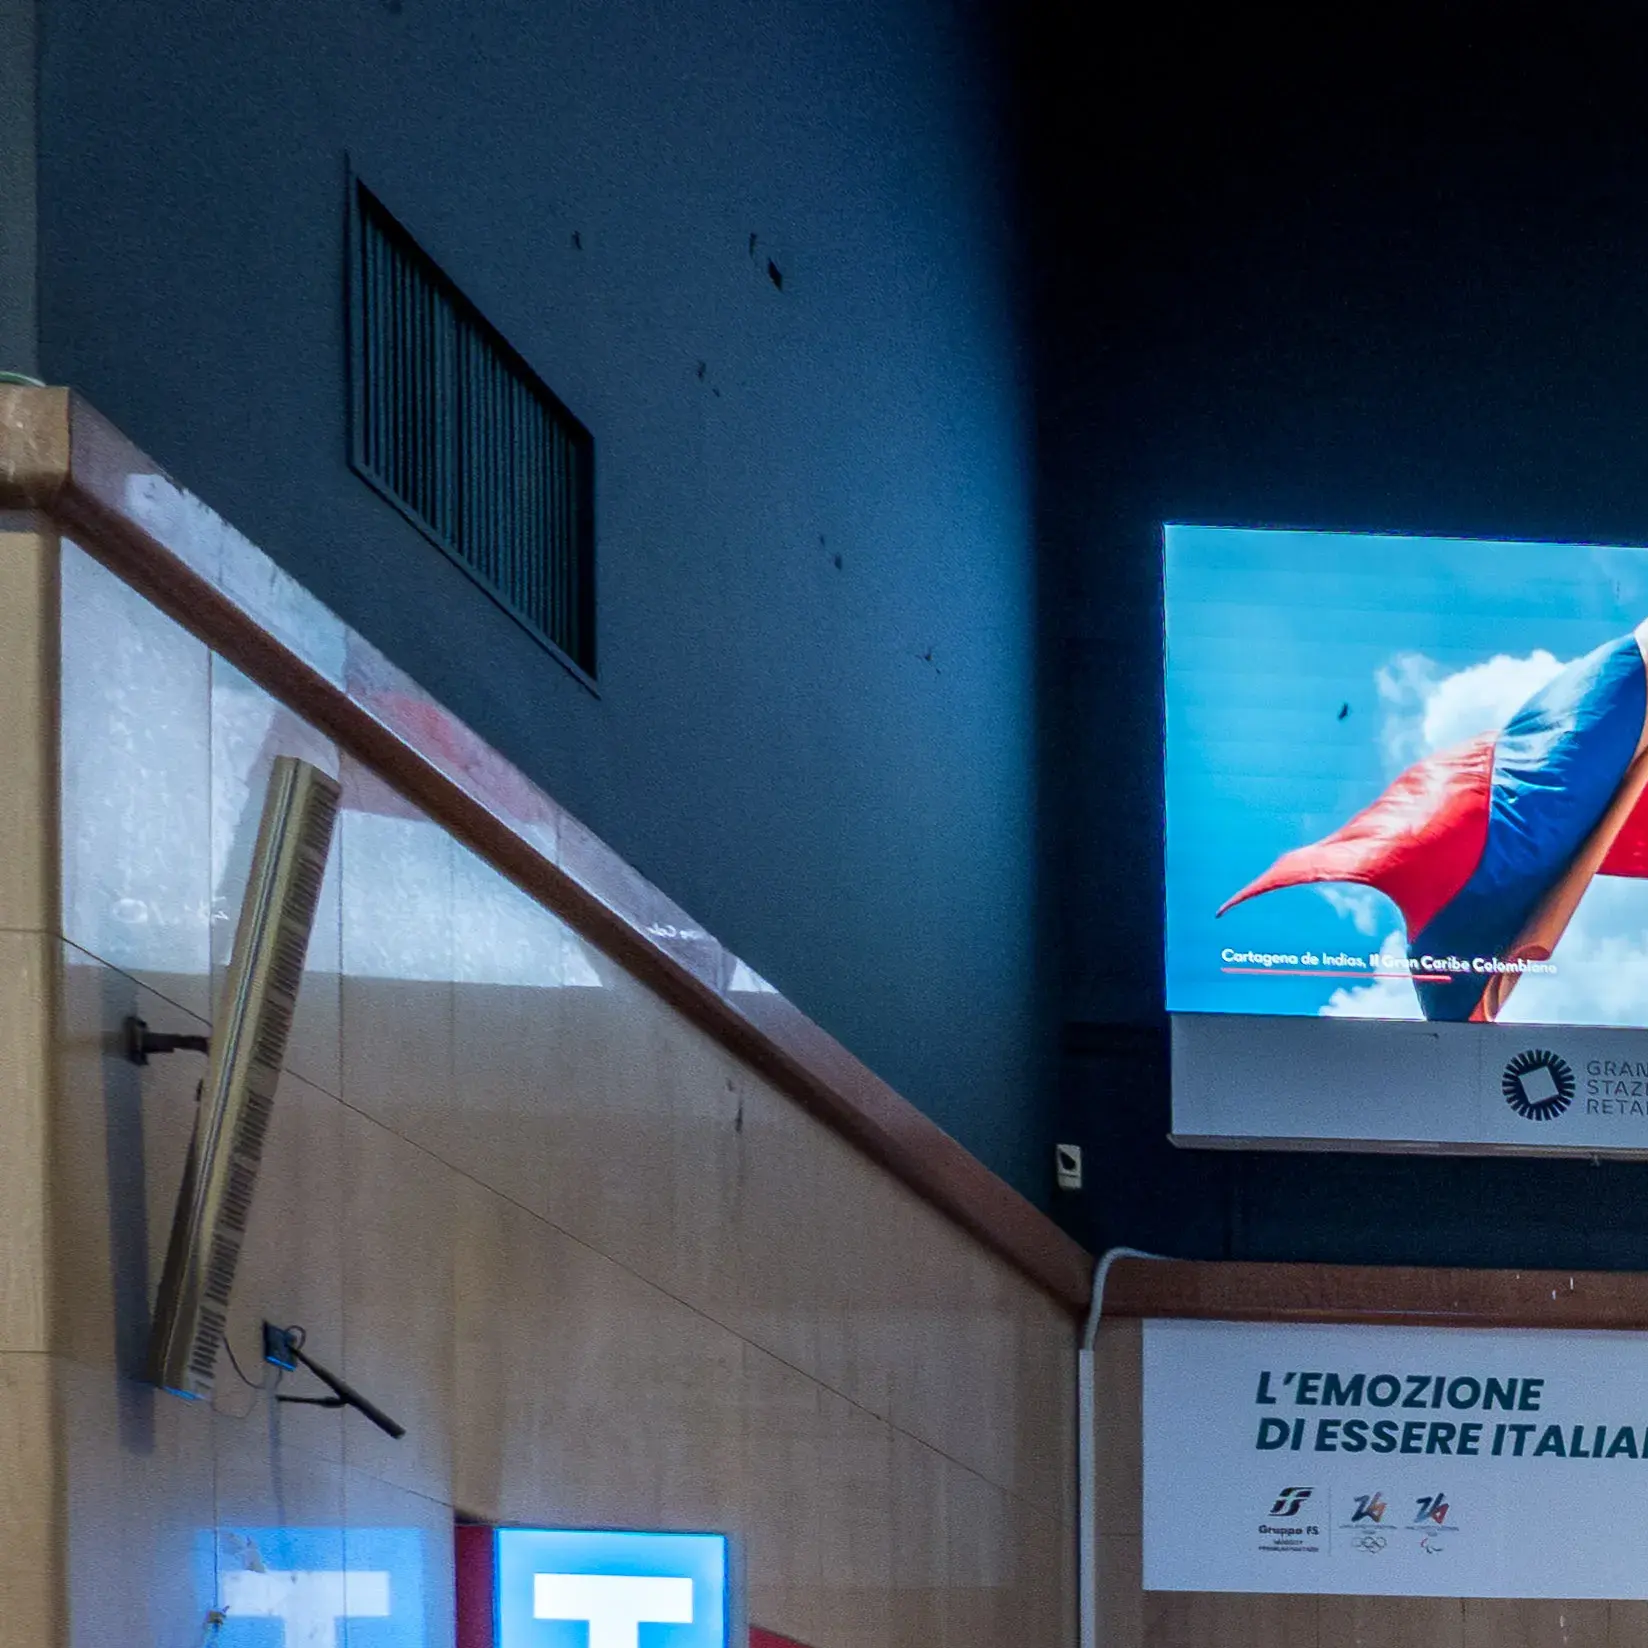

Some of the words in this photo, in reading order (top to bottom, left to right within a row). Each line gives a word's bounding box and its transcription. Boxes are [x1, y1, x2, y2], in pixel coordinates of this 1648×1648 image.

[1221, 948, 1299, 967] Cartagena
[1301, 952, 1319, 966] de
[1322, 952, 1366, 969] Indias,
[1382, 955, 1418, 969] Gran
[1421, 955, 1470, 971] Caribe
[1472, 958, 1557, 974] Colombiano
[1255, 1417, 1305, 1451] DI
[1314, 1418, 1483, 1456] ESSERE
[1258, 1525, 1303, 1537] Gruppo
[1306, 1526, 1320, 1536] FS
